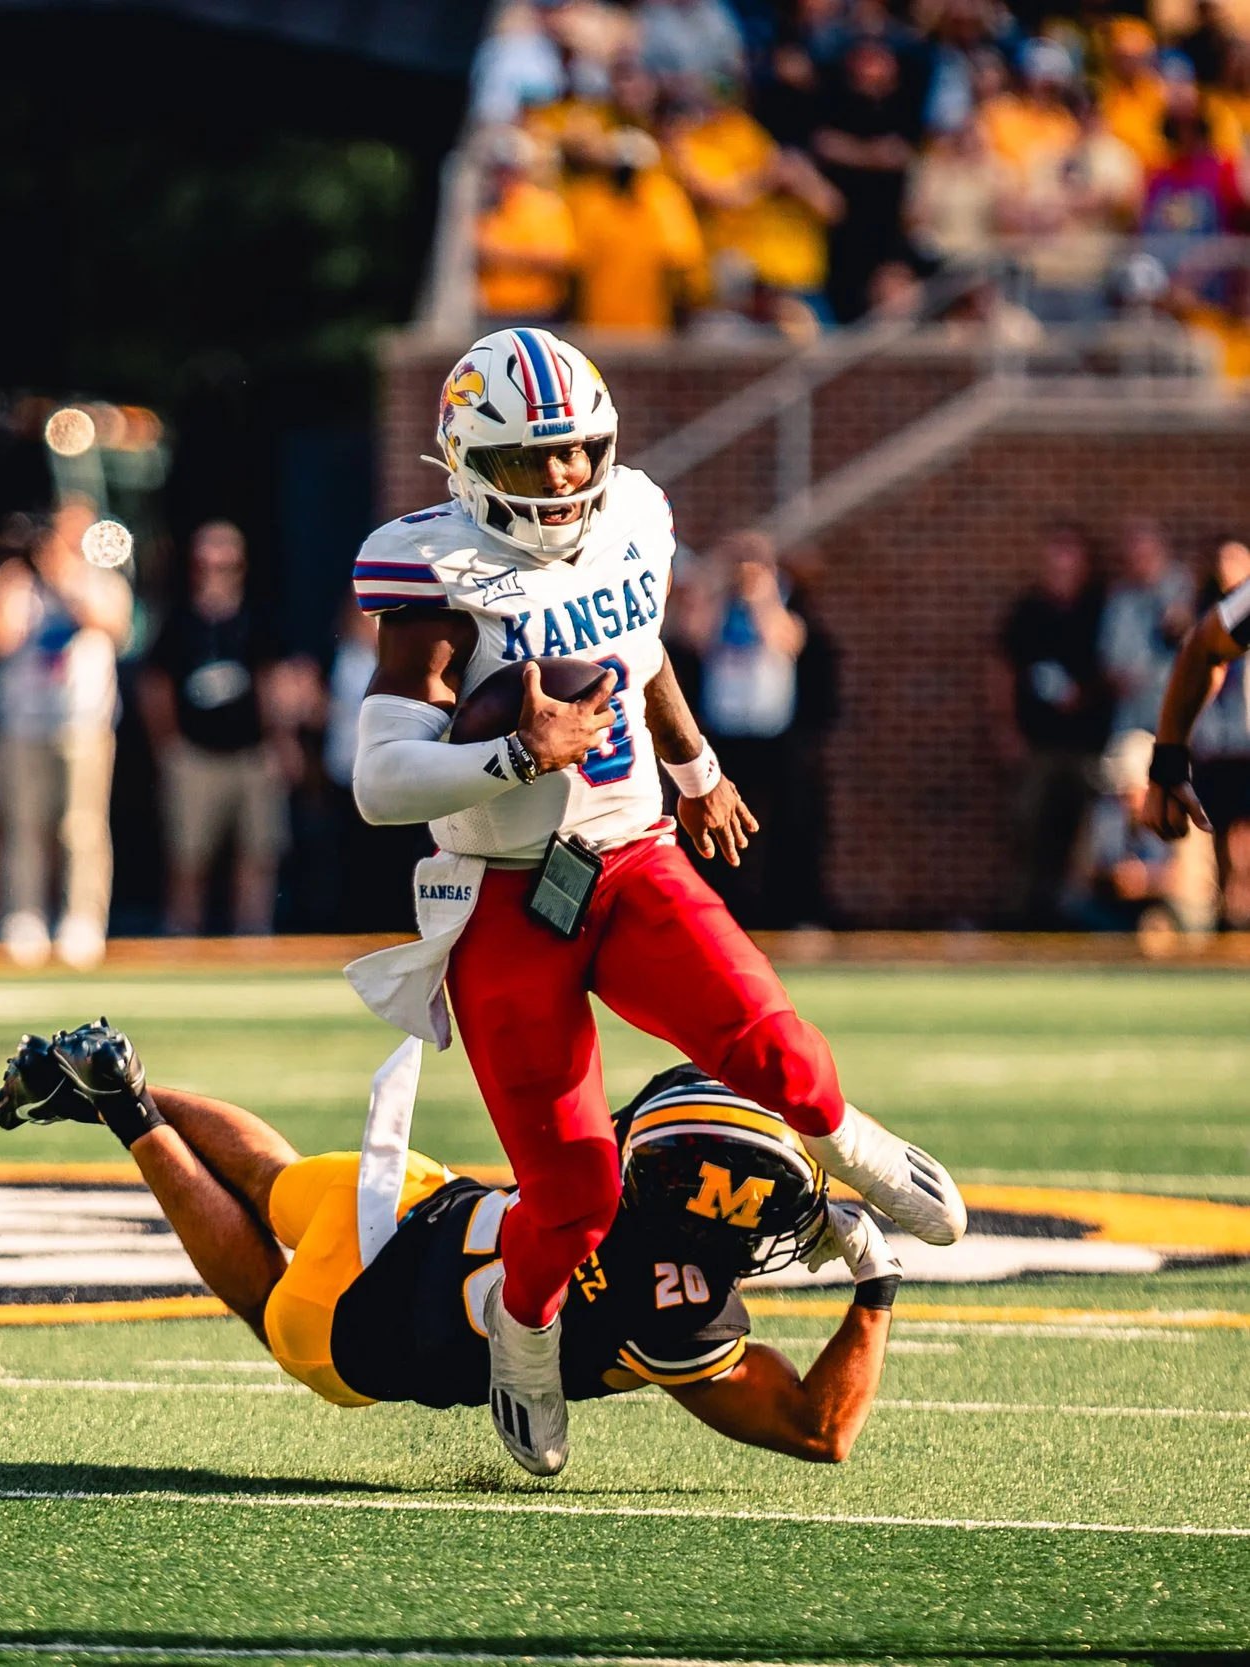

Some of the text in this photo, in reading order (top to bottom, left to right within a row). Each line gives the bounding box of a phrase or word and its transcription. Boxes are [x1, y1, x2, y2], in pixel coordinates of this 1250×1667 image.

[501, 569, 658, 661] KANSAS
[419, 884, 472, 901] KANSAS
[686, 1160, 775, 1229] M
[654, 1262, 711, 1310] 20
